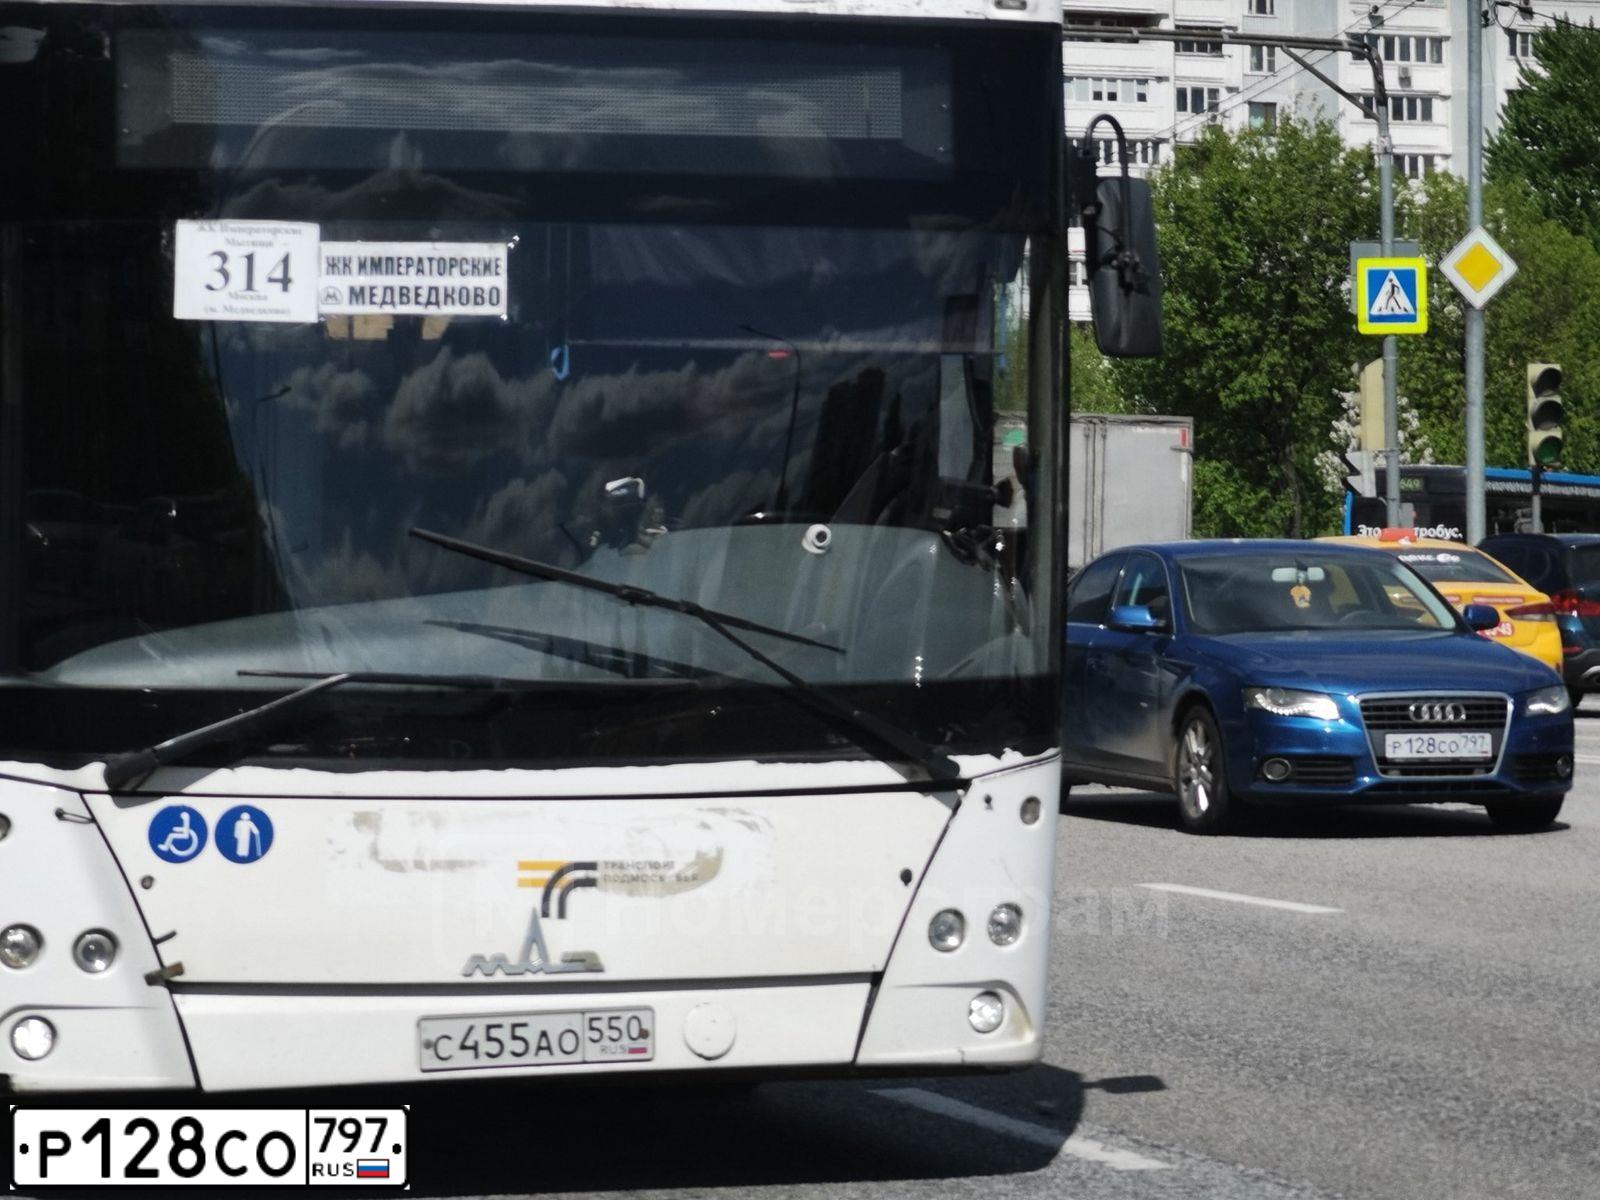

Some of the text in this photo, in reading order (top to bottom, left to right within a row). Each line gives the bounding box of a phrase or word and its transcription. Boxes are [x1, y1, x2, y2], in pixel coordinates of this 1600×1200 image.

[205, 250, 292, 292] 314
[326, 256, 502, 277] ЖК ИМПЕРАТОРСКИЕ
[349, 286, 500, 309] МЕДВЕДКОВО
[1358, 524, 1463, 540] Это тробус.
[588, 1015, 642, 1043] 550
[600, 1045, 626, 1055] RUS
